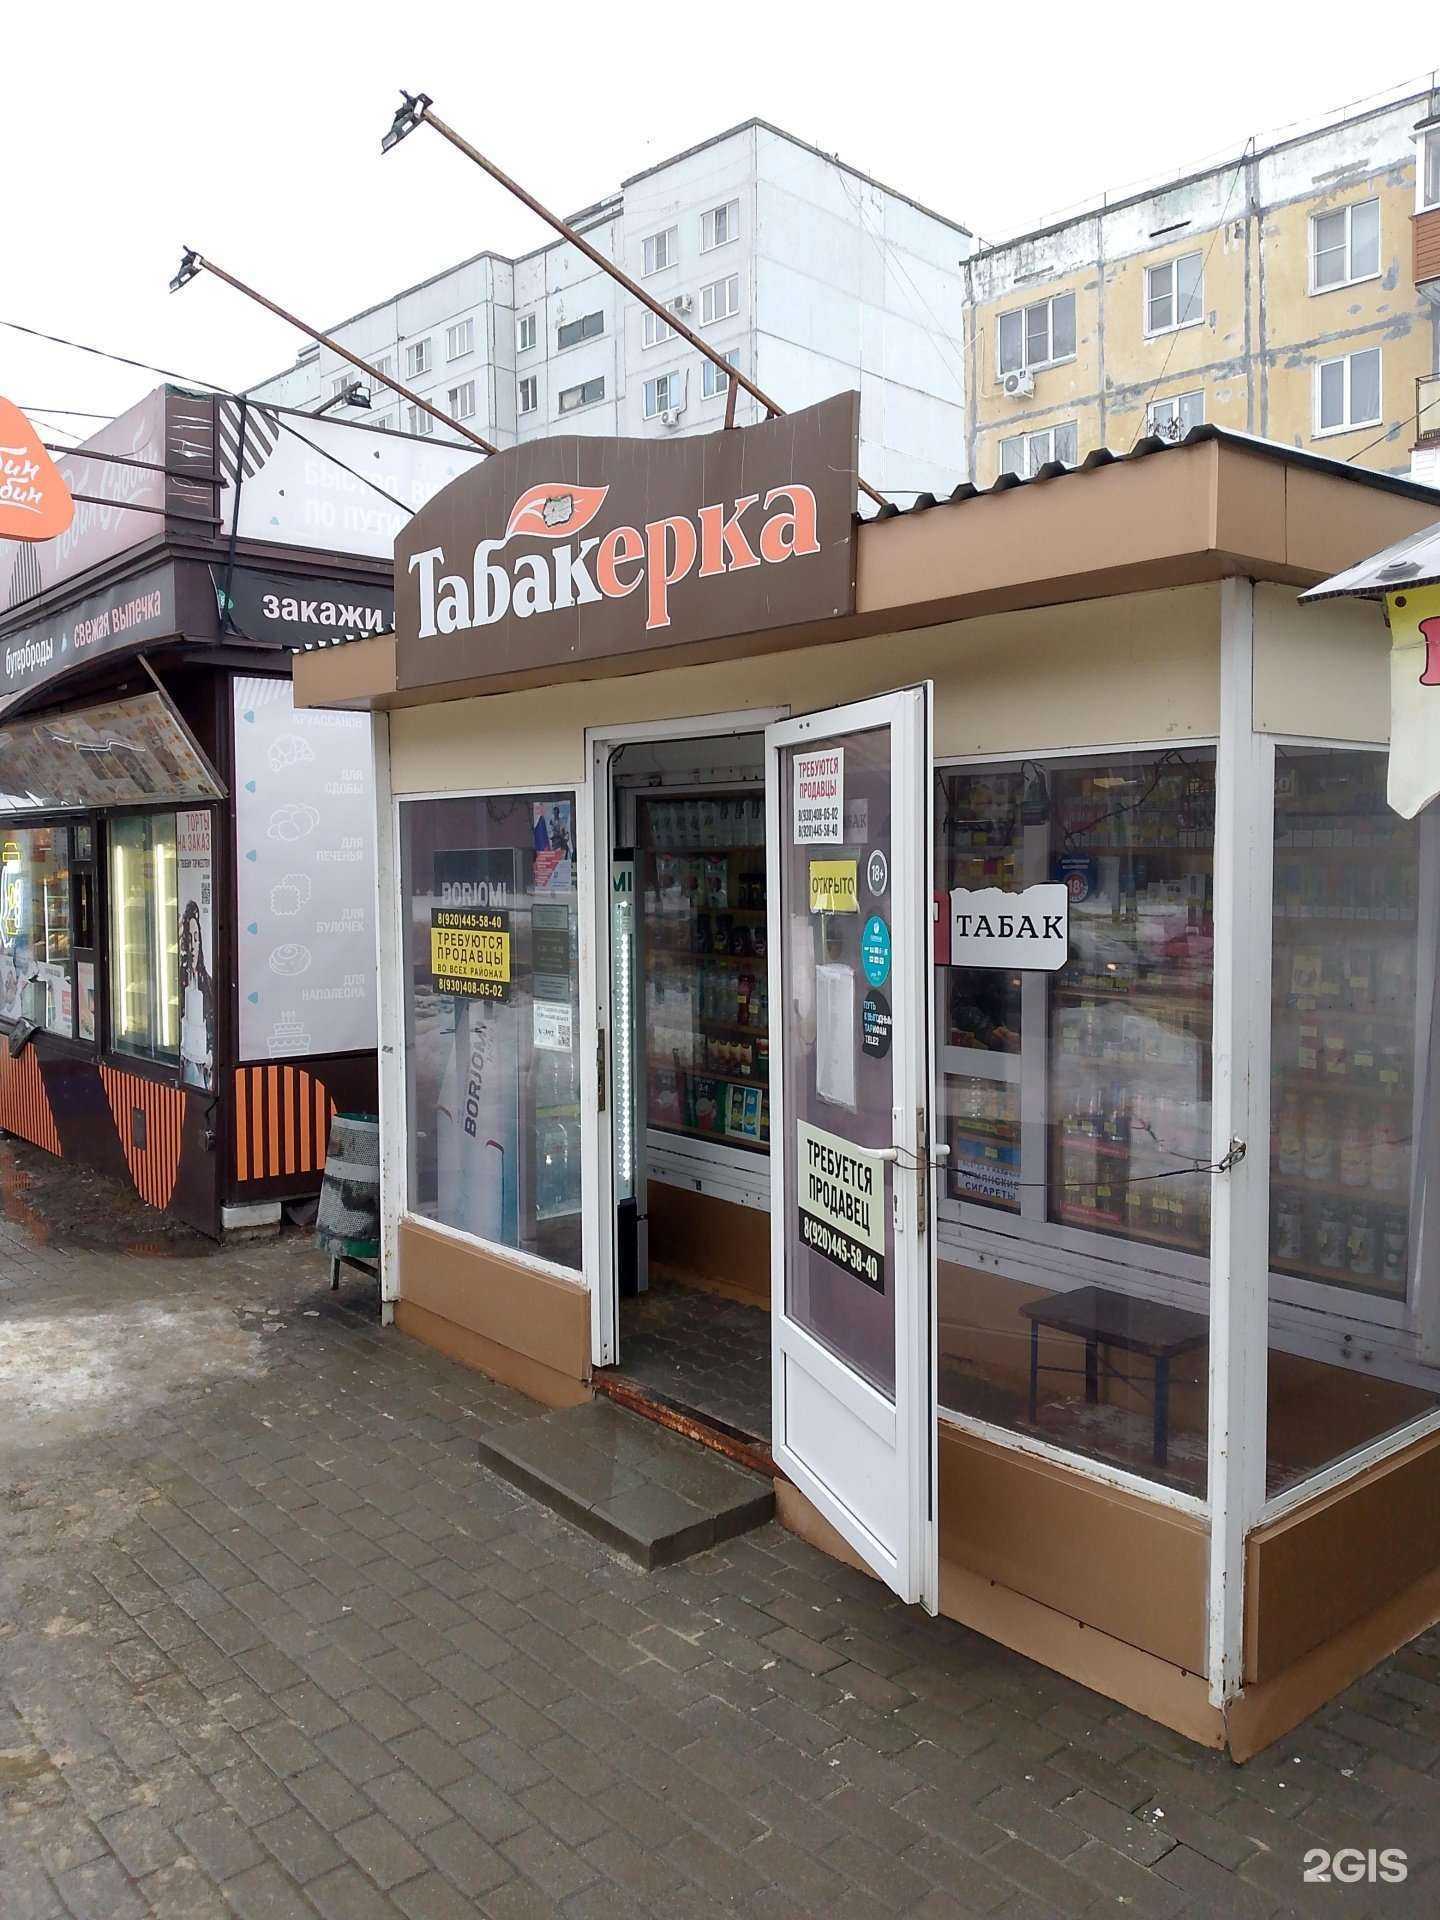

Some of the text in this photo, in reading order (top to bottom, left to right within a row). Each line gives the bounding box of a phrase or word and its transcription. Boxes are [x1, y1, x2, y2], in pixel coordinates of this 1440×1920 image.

[408, 483, 821, 638] Табакерка
[74, 590, 161, 648] свежая выпечка
[262, 594, 384, 632] закажи
[5, 637, 53, 679] бутерброды
[799, 757, 838, 778] ТРЕБУЮТСЯ
[799, 780, 836, 800] ПРОДАВЦЫ
[186, 813, 210, 831] ТОРТЫ
[871, 864, 884, 881] 18+
[441, 881, 507, 906] BORJOMI
[812, 876, 855, 896] ОТКРЫТО
[316, 921, 364, 933] БУЛОЧЕК
[437, 912, 502, 929] 8(920)445-58-40
[956, 914, 1064, 939] ТАБАК
[437, 932, 503, 949] ТРЕБУЮТСЯ
[437, 947, 503, 966] ПРОДАВЦЫ
[438, 963, 503, 979] ВО ВСЕХ РАЙОНАХ
[438, 978, 503, 997] 8(930)408-05-02
[807, 1138, 872, 1196] ТРЕБУЕТСЯ
[965, 1181, 1016, 1201] СИГАРЕТЫ
[808, 1173, 870, 1237] ПРОДАВЕЦ
[803, 1216, 877, 1283] 8(920)445-58-40
